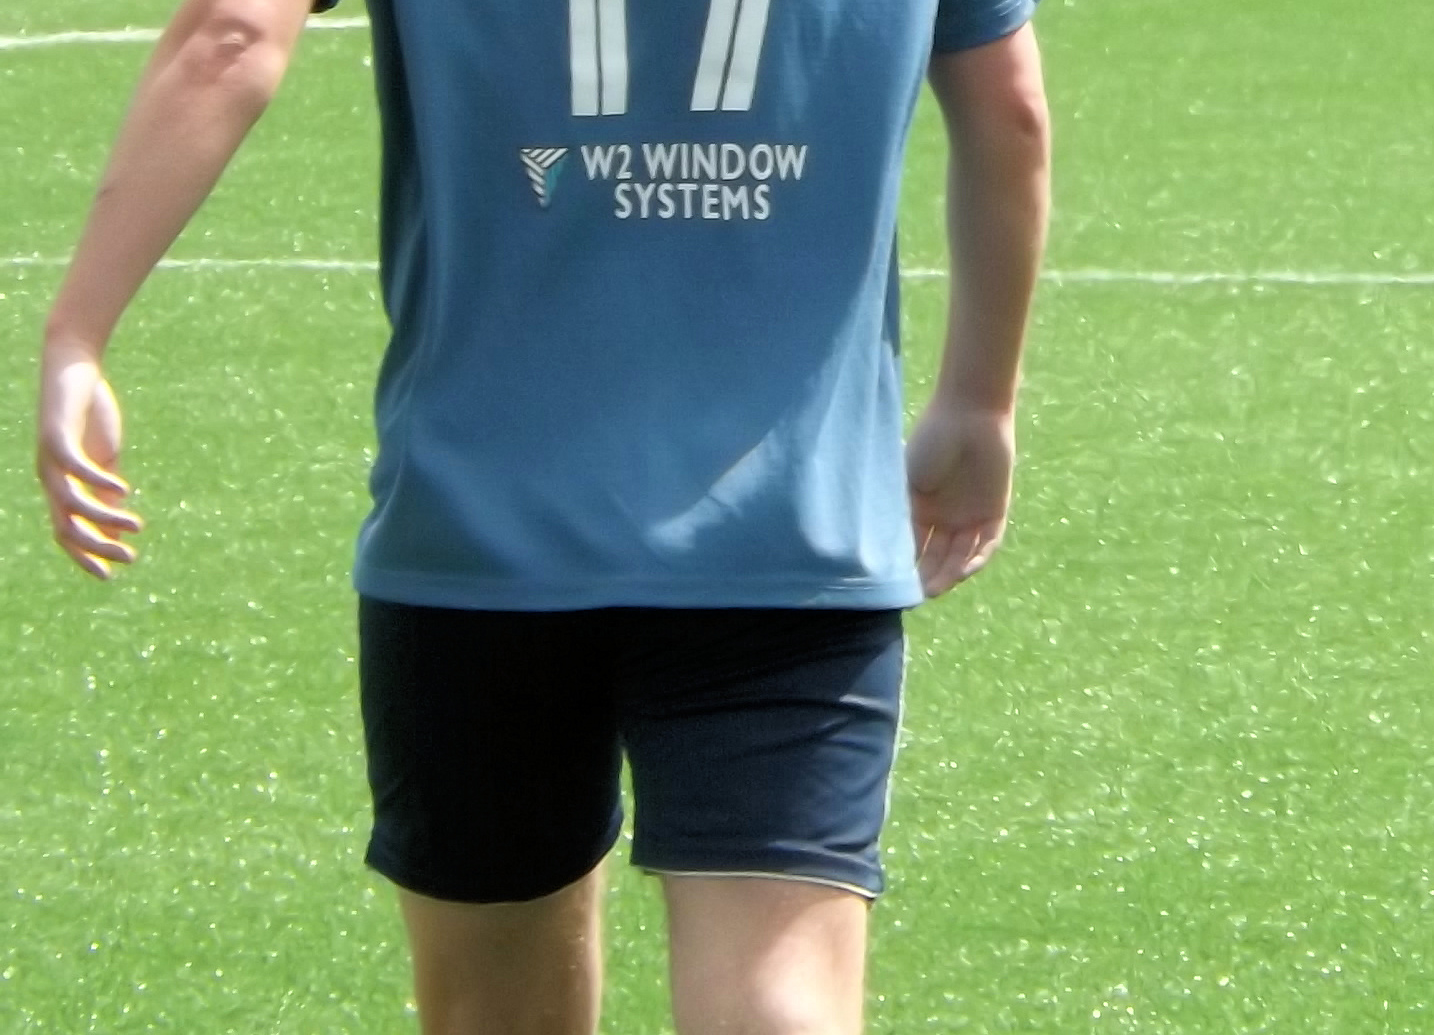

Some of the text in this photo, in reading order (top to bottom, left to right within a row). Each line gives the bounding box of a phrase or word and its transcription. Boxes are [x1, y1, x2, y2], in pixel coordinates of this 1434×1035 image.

[581, 143, 807, 181] W2 WINDOW
[614, 183, 770, 221] SYSTEMS
